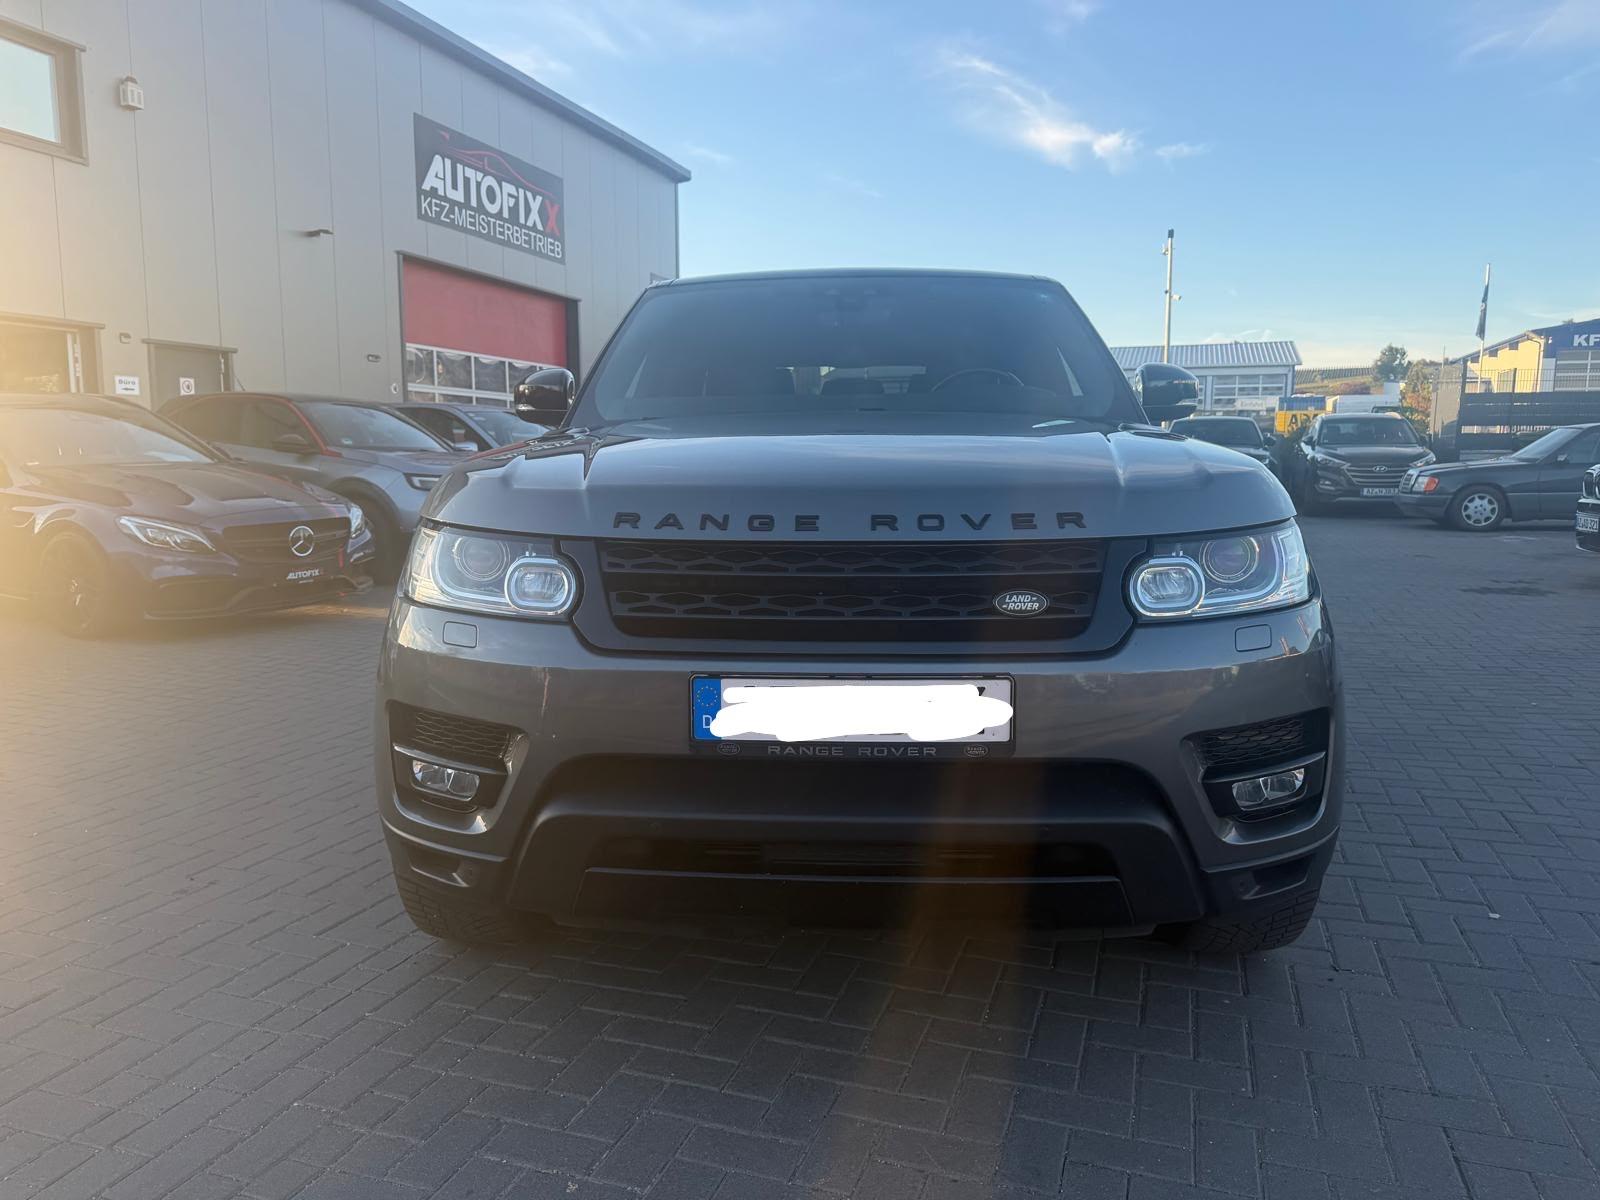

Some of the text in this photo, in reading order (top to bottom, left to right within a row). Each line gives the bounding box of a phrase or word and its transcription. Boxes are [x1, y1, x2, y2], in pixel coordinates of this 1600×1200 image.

[420, 194, 563, 259] KFZ-MEISTERBETRIEB
[613, 511, 1087, 532] RANGE ROVER
[1005, 594, 1031, 603] LAND
[1007, 602, 1039, 611] ROVER
[767, 745, 937, 757] RANGE ROVER
